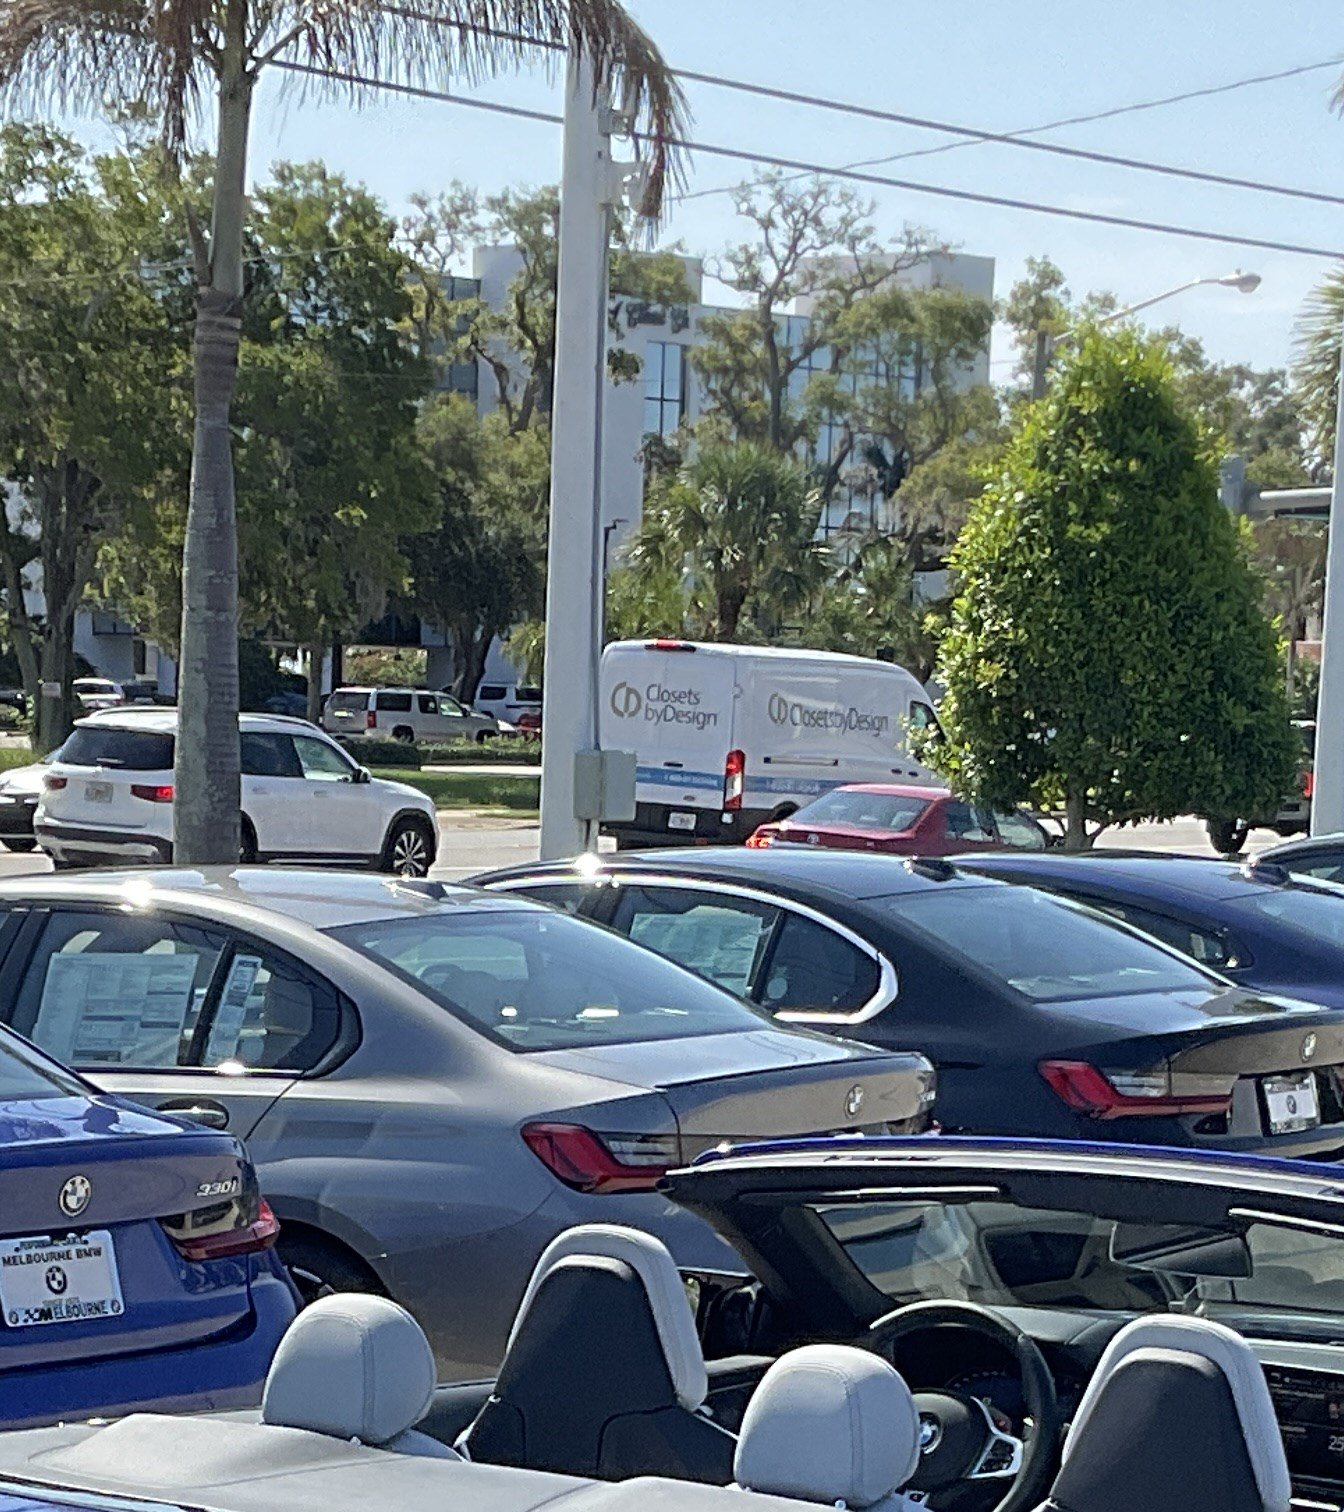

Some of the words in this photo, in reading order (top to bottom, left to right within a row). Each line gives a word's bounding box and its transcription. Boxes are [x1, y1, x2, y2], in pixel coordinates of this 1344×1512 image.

[646, 684, 701, 705] Closets
[644, 703, 718, 730] byDesign
[2, 1251, 74, 1266] MELBOURNE
[76, 1247, 102, 1259] BMW
[38, 1300, 109, 1321] MELBOURNE
